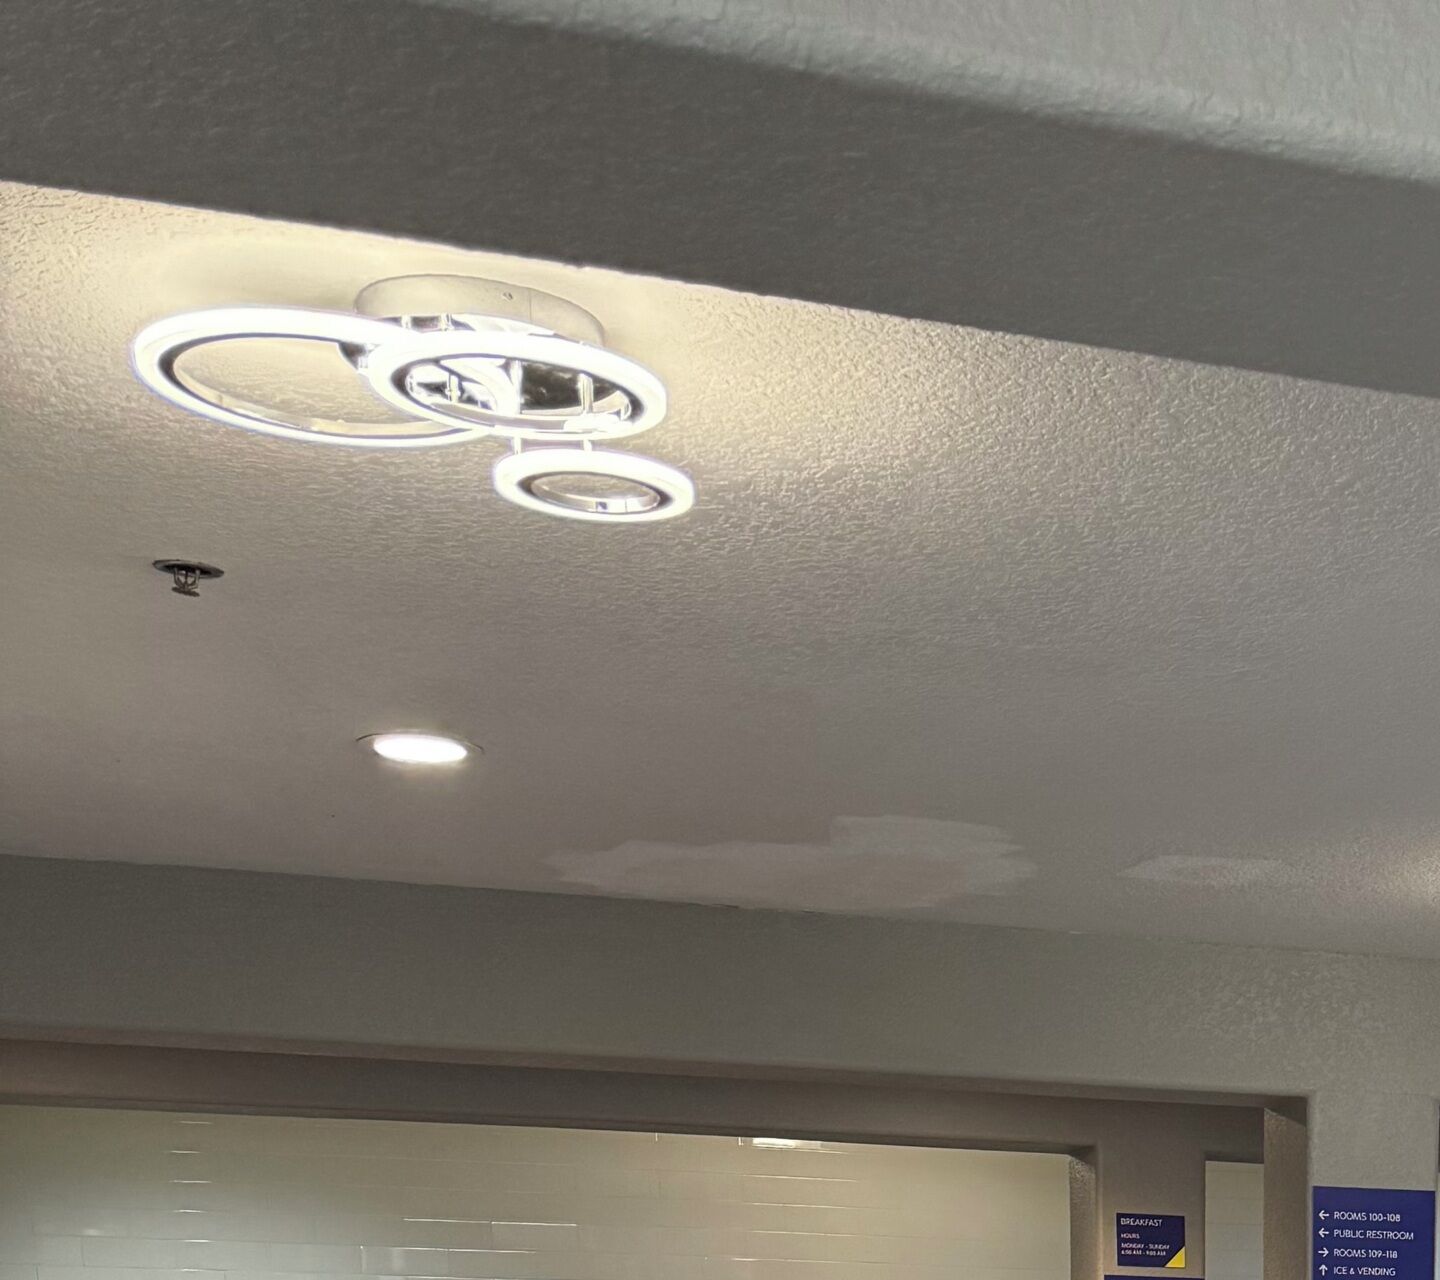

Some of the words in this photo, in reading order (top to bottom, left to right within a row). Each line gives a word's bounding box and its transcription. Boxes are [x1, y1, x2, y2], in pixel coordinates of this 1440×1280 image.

[1333, 1211, 1367, 1221] ROOMS
[1368, 1213, 1401, 1222] 100-108
[1120, 1218, 1162, 1227] BREAKFAST
[1333, 1228, 1365, 1239] PUBLIC
[1366, 1230, 1414, 1240] RESTROOM
[1333, 1248, 1367, 1258] ROOMS
[1368, 1250, 1398, 1259] 109-118
[1333, 1266, 1348, 1275] ICE
[1349, 1267, 1355, 1275] &
[1357, 1267, 1396, 1276] VENDING
